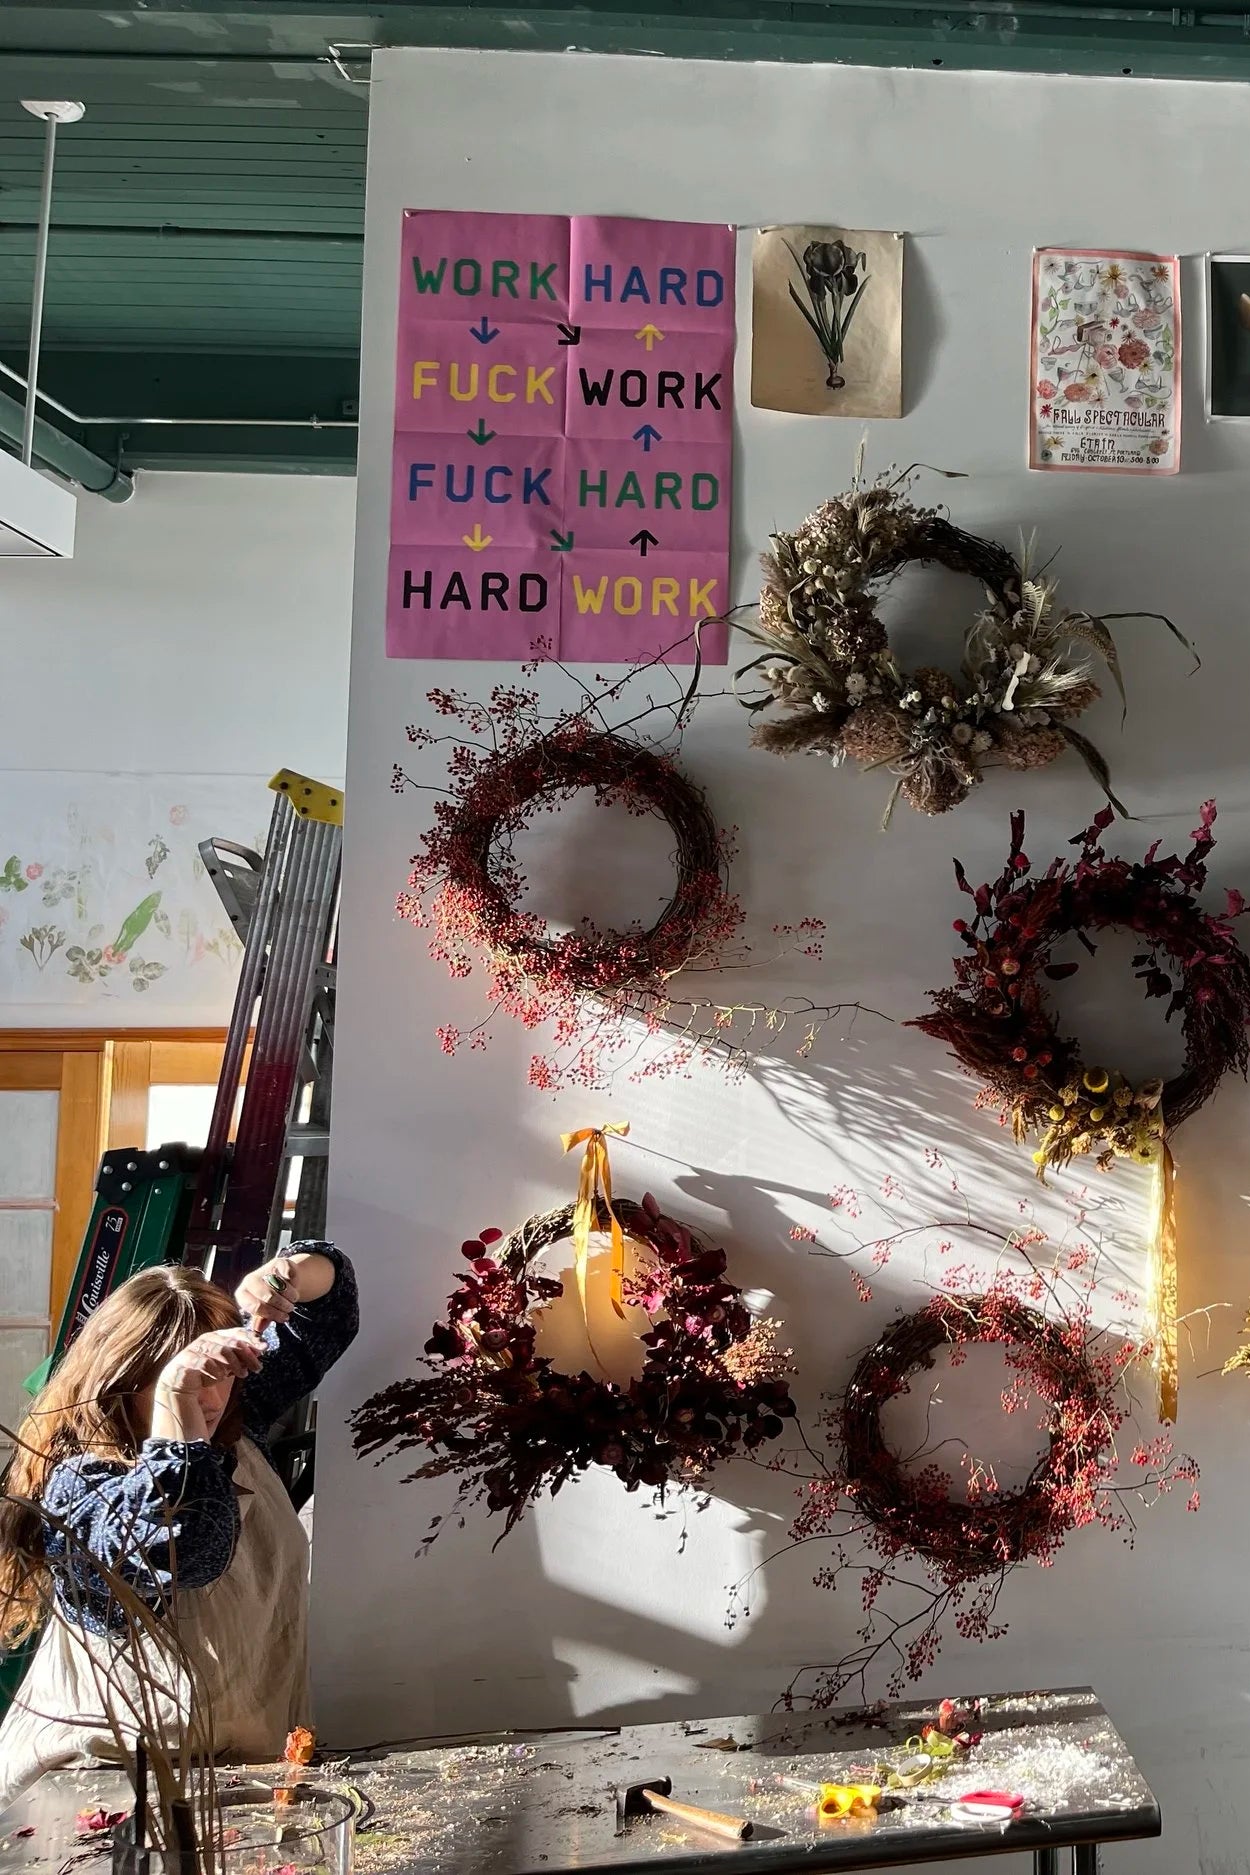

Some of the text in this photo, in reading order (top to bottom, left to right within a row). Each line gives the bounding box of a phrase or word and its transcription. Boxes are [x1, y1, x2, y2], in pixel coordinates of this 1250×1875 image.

[412, 256, 725, 308] WORK HARD
[412, 361, 723, 411] FUCK WORK
[1053, 408, 1165, 428] FALL SPECTACULAR
[1061, 452, 1085, 463] FRIDAY
[1087, 454, 1116, 463] OCTOBER
[408, 463, 720, 511] FUCK HARD
[402, 571, 719, 617] HARD WORK
[80, 1250, 110, 1315] Louisville
